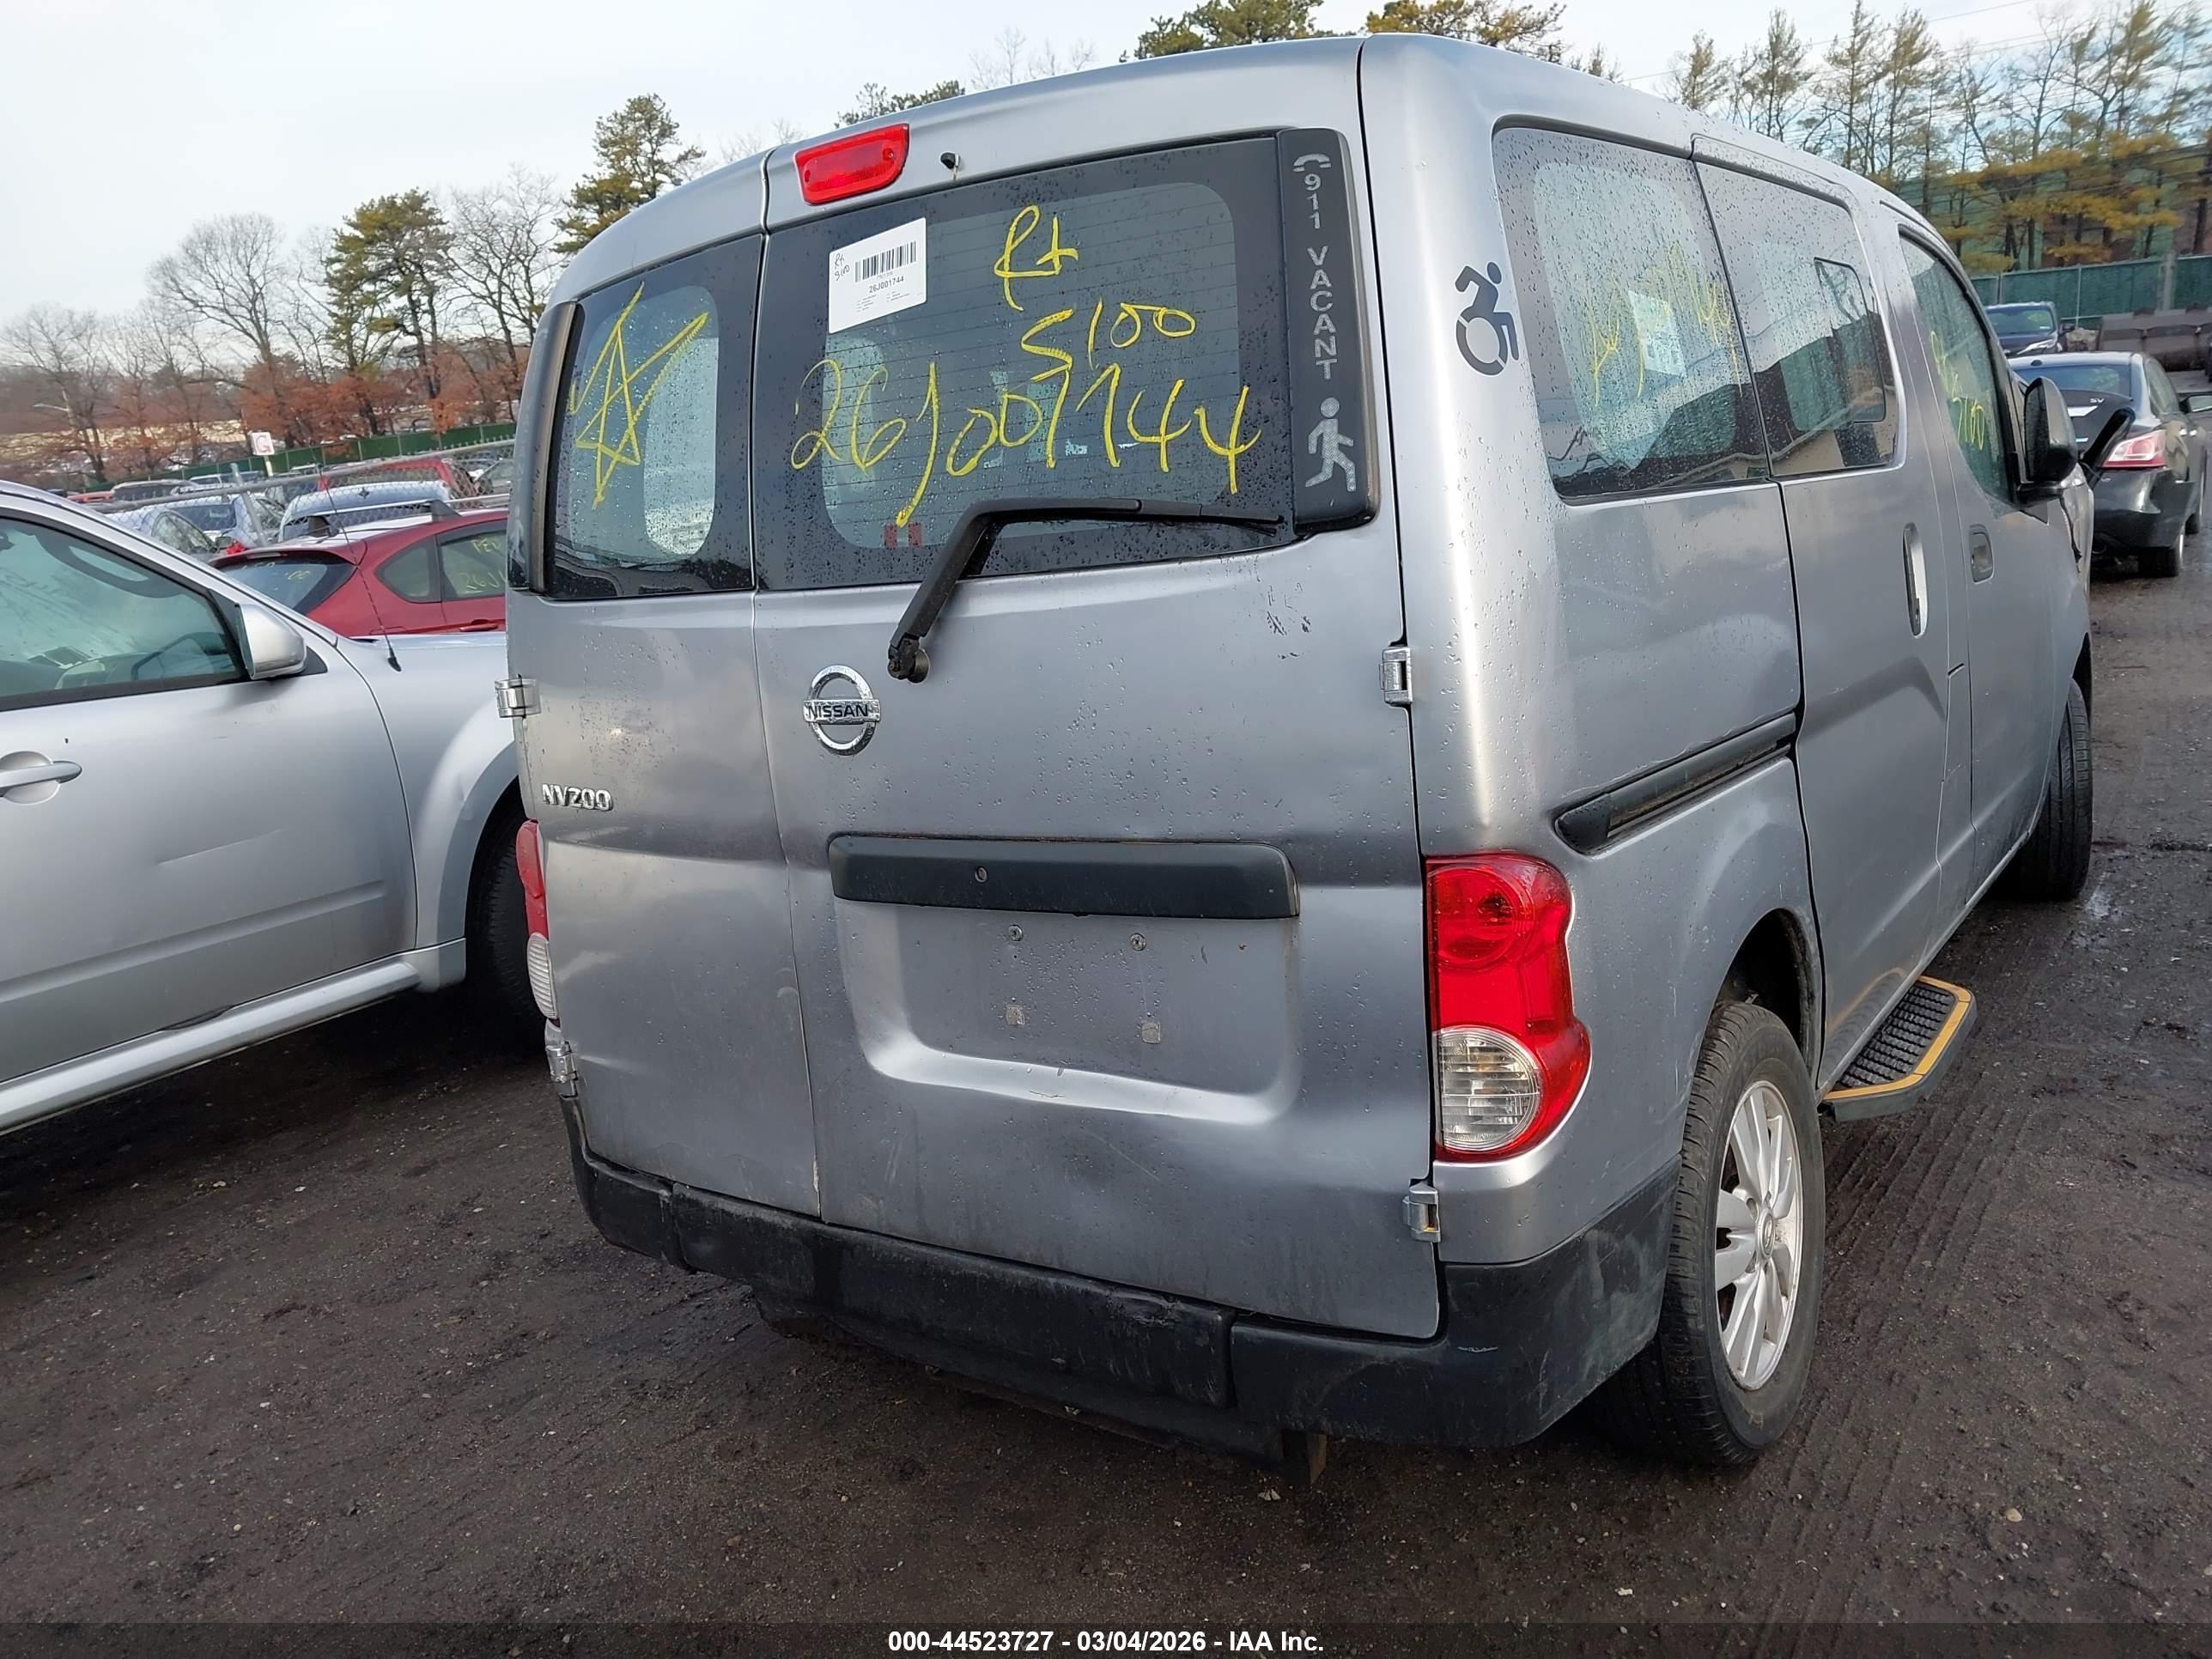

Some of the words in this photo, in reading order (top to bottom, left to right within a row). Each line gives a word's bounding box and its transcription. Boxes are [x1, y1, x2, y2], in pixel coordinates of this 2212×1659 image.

[1304, 173, 1322, 230] 911
[869, 276, 904, 293] 26J001744
[1307, 245, 1338, 380] VACANT
[808, 703, 868, 719] NISSAN
[542, 782, 613, 811] NV200
